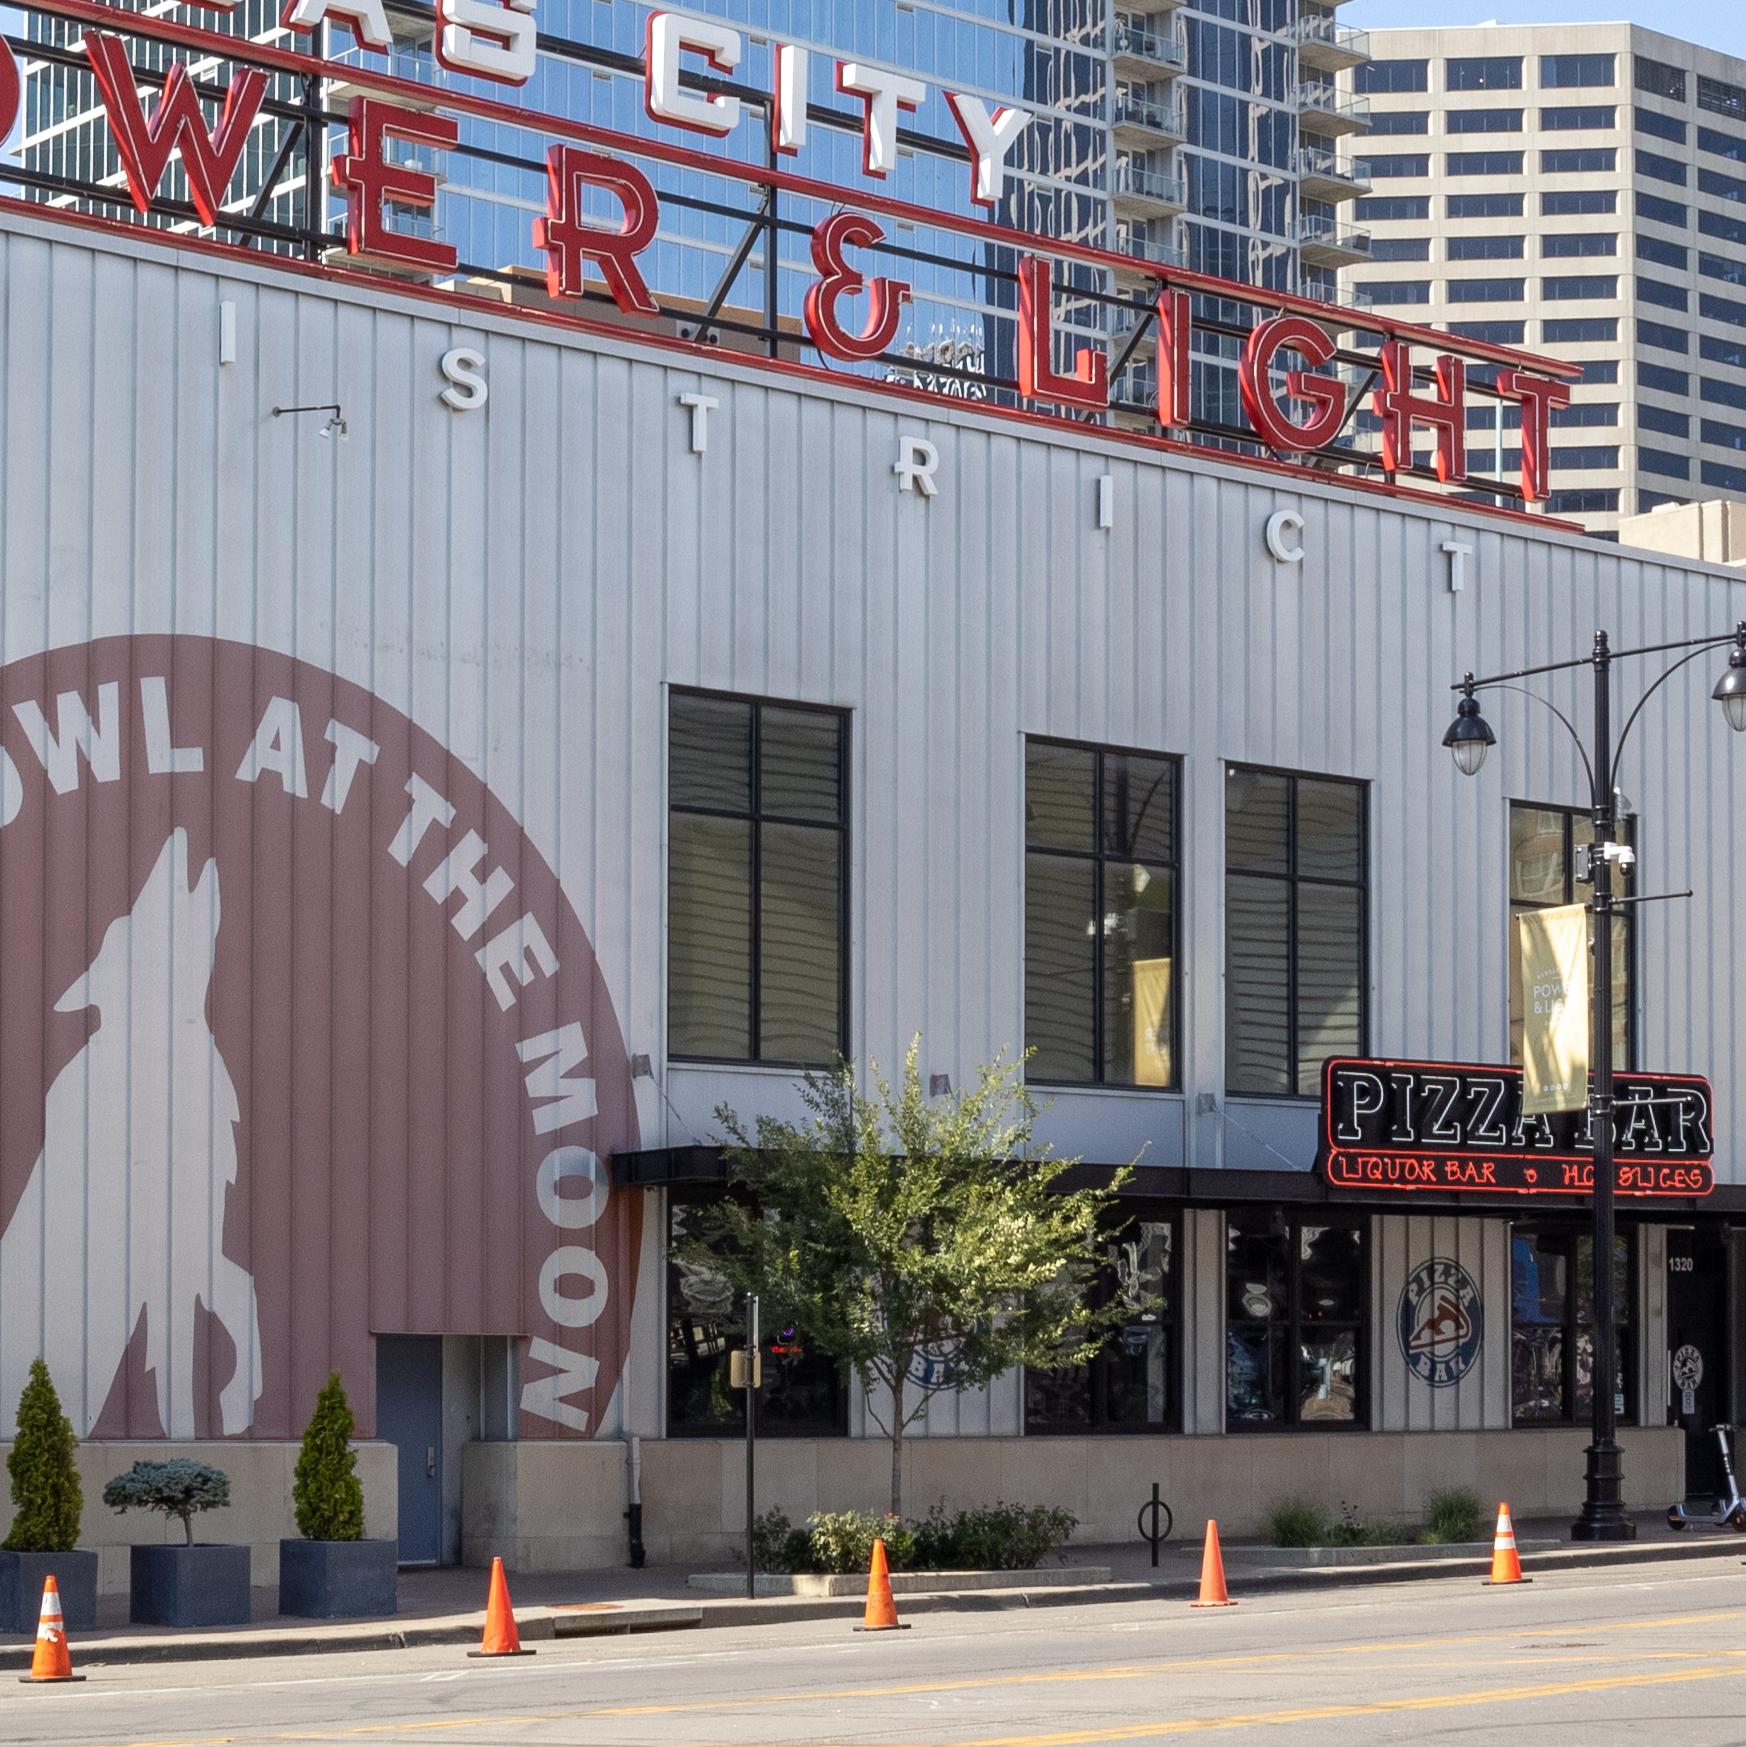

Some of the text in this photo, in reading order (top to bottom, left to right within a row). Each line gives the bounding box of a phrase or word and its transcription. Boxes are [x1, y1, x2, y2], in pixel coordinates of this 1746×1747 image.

[645, 9, 1031, 207] CITY
[804, 211, 912, 362] &
[1017, 253, 1573, 503] LIGHT
[234, 695, 381, 816] AT
[386, 770, 561, 1012] THE
[513, 1020, 611, 1434] MOON
[1339, 1156, 1704, 1189] LIQUOR BAR HO SLICES
[1408, 1264, 1475, 1307] PIZZA
[1668, 1257, 1694, 1272] 1320
[1416, 1355, 1467, 1382] BAR
